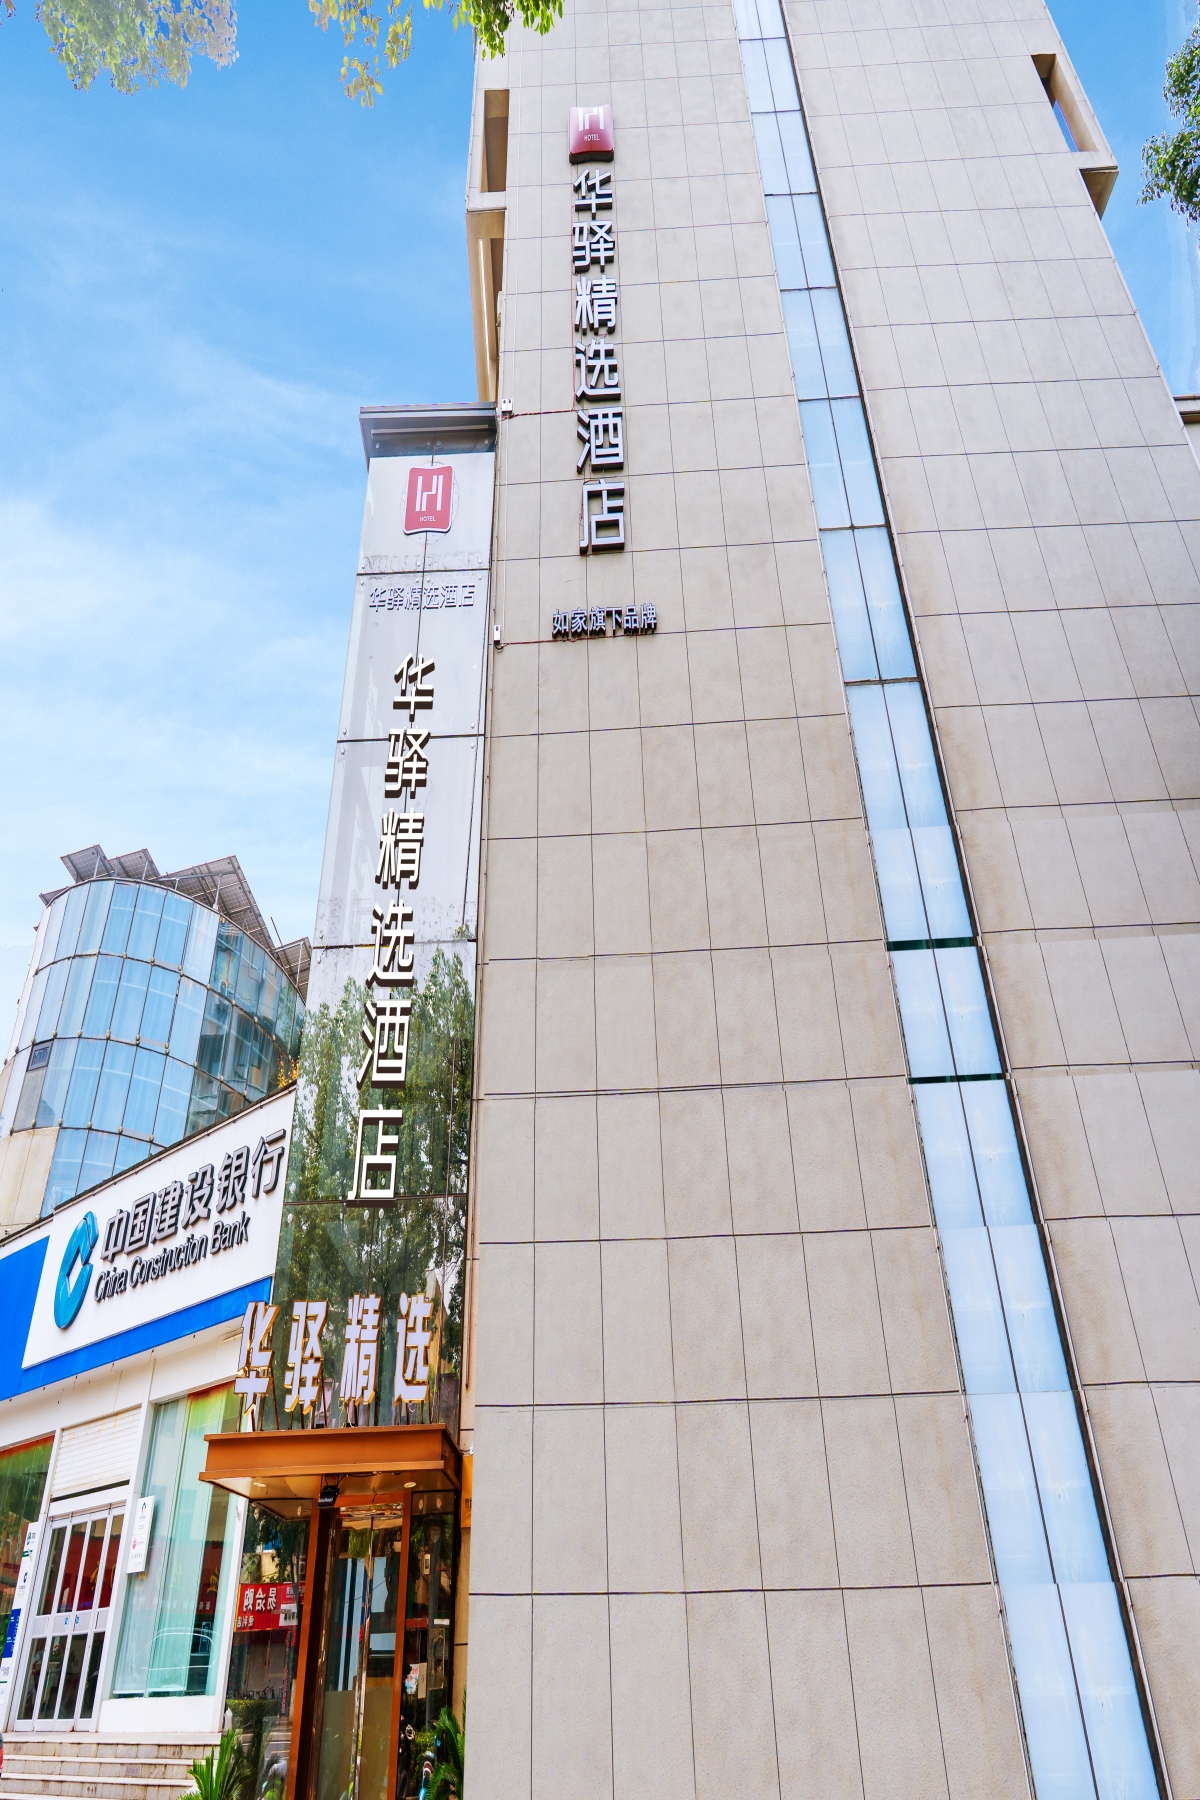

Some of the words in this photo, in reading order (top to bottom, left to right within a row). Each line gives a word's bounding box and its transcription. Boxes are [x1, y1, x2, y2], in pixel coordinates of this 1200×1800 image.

[583, 134, 600, 142] HOTEL
[572, 168, 625, 556] 华驿精选酒店
[368, 583, 476, 612] 华驿精选酒店
[551, 603, 658, 639] 如家旗下品牌
[347, 651, 436, 1206] 华驿精选酒店
[100, 1128, 286, 1263] 中国建设银行
[94, 1266, 127, 1303] China
[129, 1233, 208, 1289] Construction
[209, 1211, 251, 1255] Bank
[234, 1291, 434, 1416] 华驿精选
